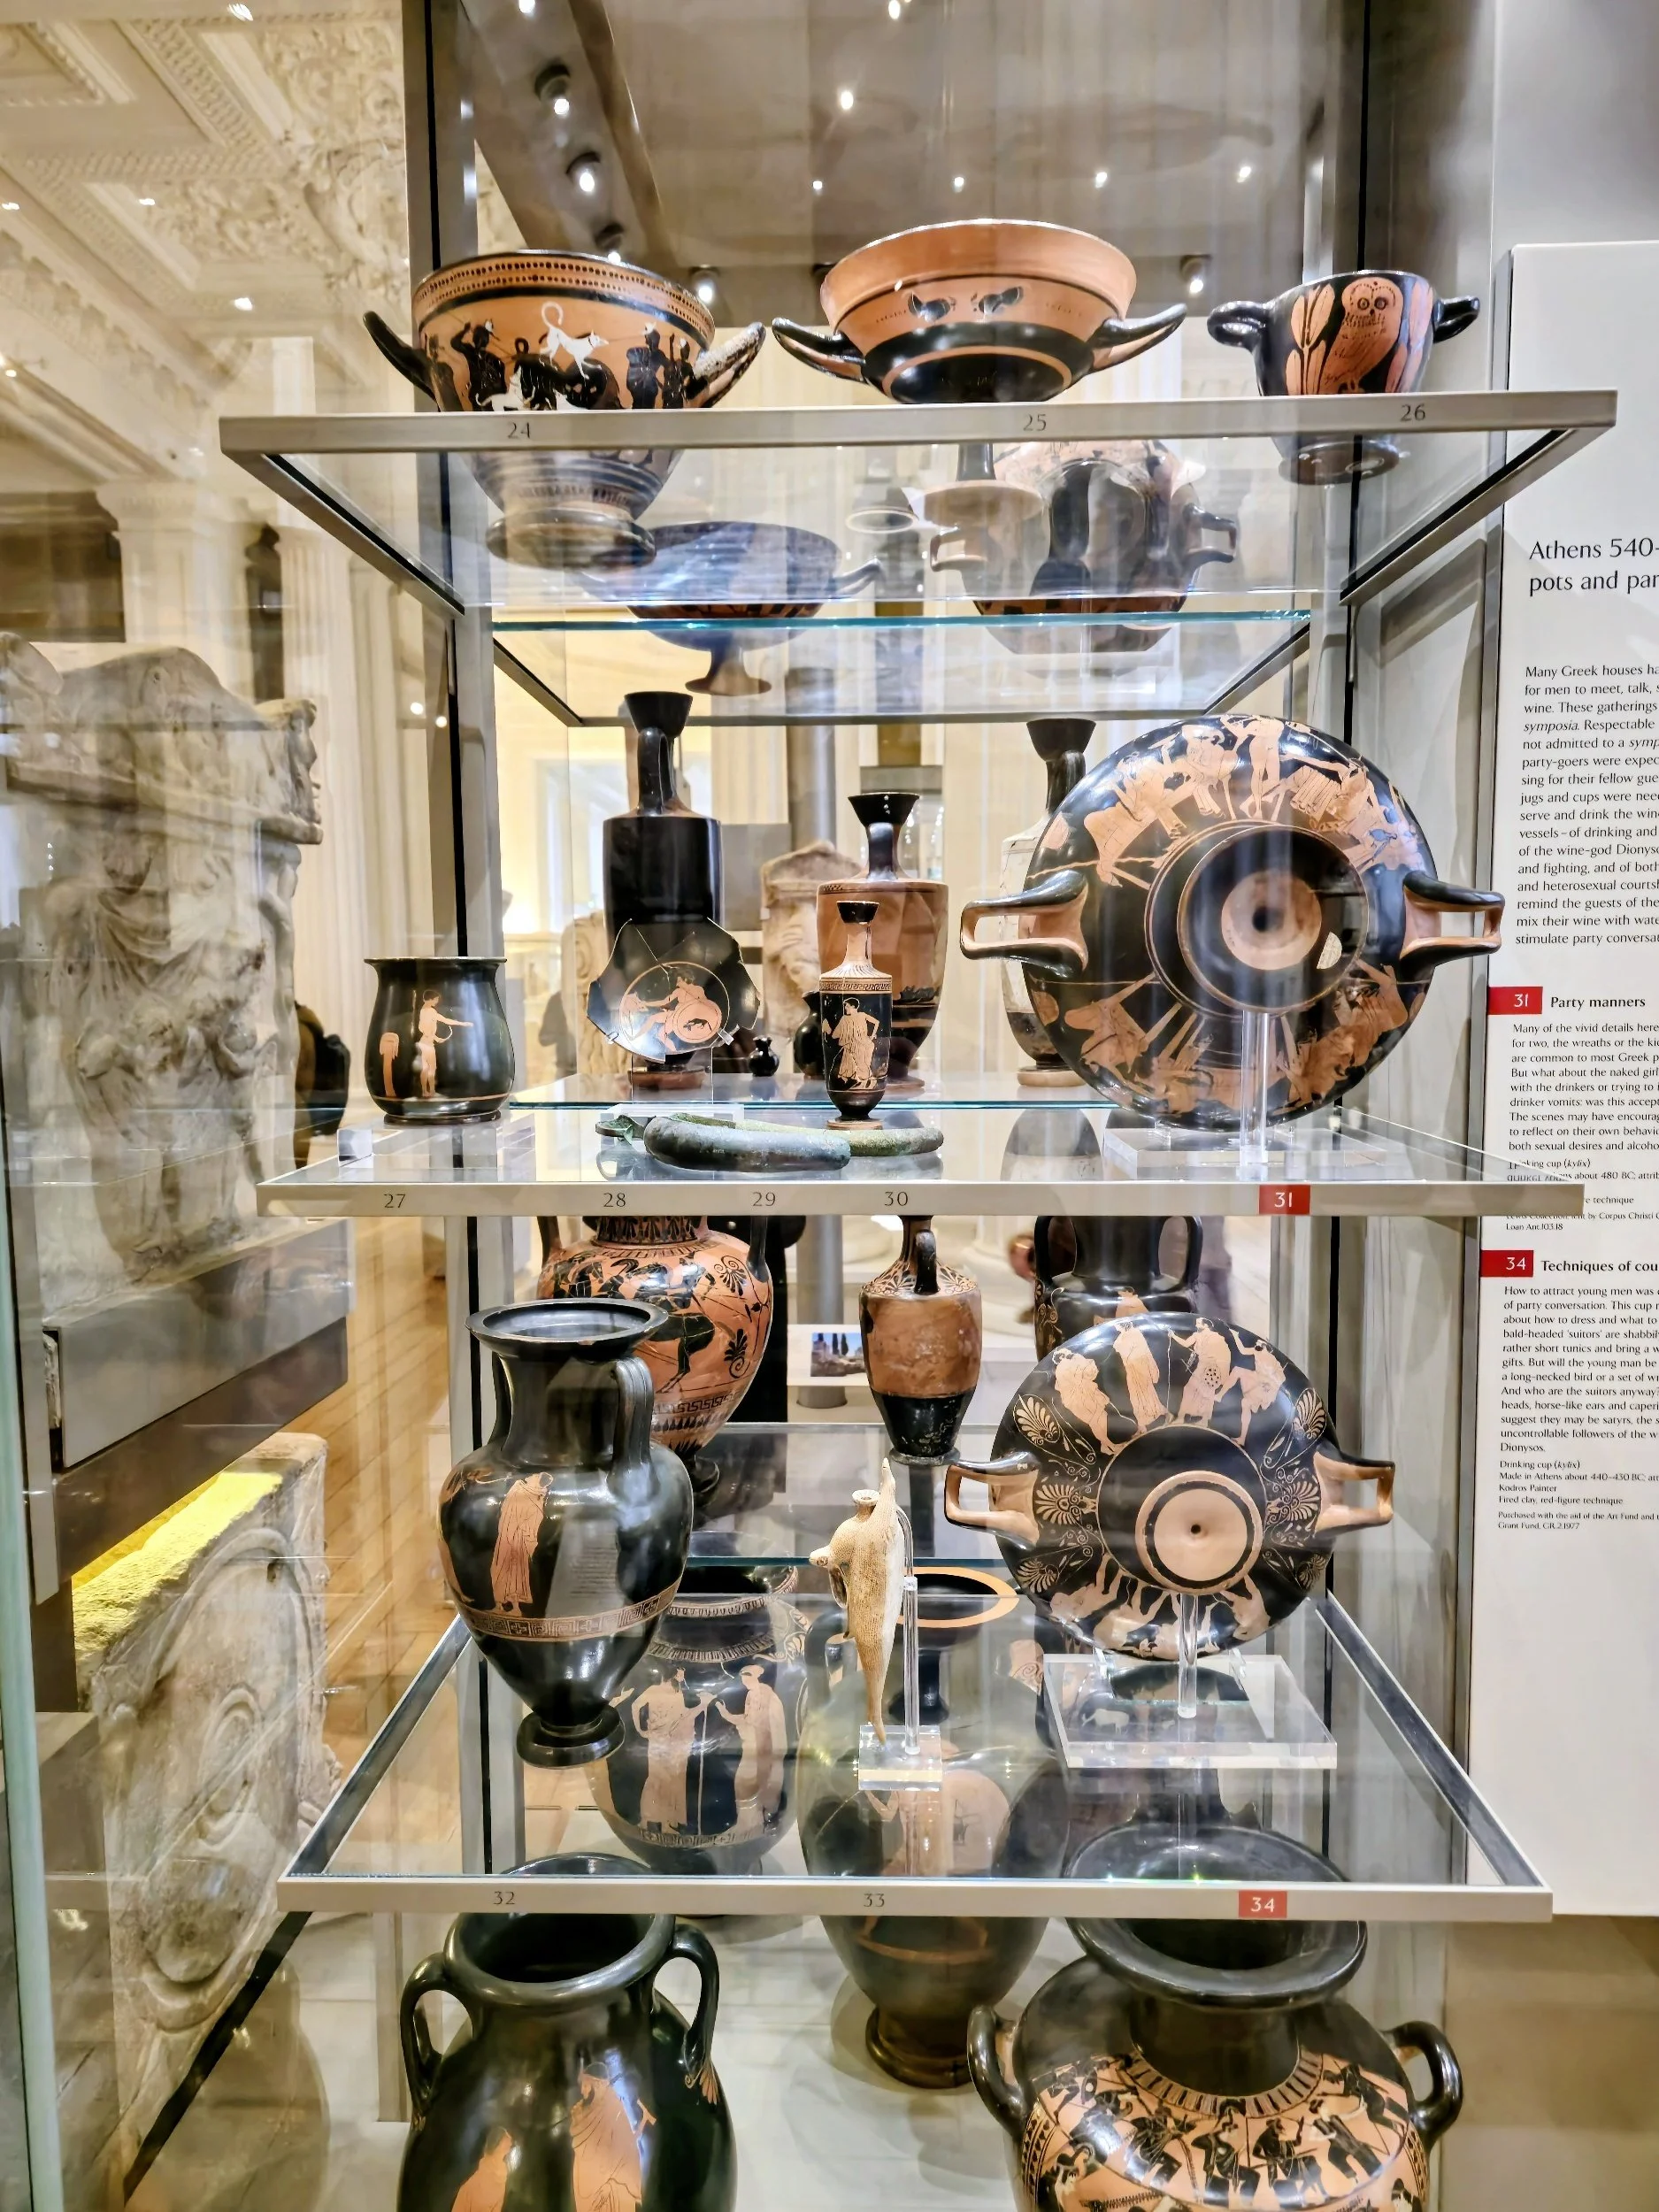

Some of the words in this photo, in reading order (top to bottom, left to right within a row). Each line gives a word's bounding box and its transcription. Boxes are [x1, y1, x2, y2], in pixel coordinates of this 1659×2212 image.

[1400, 403, 1425, 422] 26
[1023, 413, 1047, 432] 25
[506, 421, 531, 440] 24
[1528, 540, 1601, 561] Athens
[1529, 575, 1573, 598] pots
[1580, 569, 1618, 590] and
[1525, 665, 1558, 680] Many
[1561, 664, 1599, 677] Greek
[1602, 664, 1643, 676] houses
[1525, 684, 1541, 696] for
[1544, 686, 1571, 695] men
[1575, 686, 1587, 695] to
[1590, 685, 1624, 695] meet,
[1627, 681, 1652, 695] talk,
[1524, 703, 1555, 714] wine.
[1557, 701, 1594, 713] These
[1596, 700, 1658, 716] gatherings
[1523, 719, 1580, 735] symposia.
[1584, 718, 1655, 733] Respectable
[1523, 741, 1543, 750] not
[1545, 737, 1599, 749] admitted
[1602, 739, 1615, 749] to
[1617, 739, 1624, 749] a
[1522, 757, 1589, 771] party-goers
[1592, 757, 1622, 766] were
[1521, 774, 1545, 788] sing
[1548, 773, 1565, 785] for
[1568, 772, 1596, 785] their
[1599, 772, 1635, 785] fellow
[1636, 774, 1659, 787] gue
[1518, 792, 1544, 807] jugs
[1547, 791, 1569, 803] and
[1572, 794, 1600, 806] cups
[1602, 793, 1632, 802] were
[1519, 812, 1551, 821] serve
[1553, 809, 1576, 821] and
[1578, 808, 1609, 820] drink
[1614, 808, 1633, 820] the
[1518, 826, 1559, 839] vessels
[1569, 826, 1582, 838] of
[1584, 826, 1632, 841] drinking
[1635, 825, 1657, 837] and
[1518, 845, 1532, 856] of
[1533, 844, 1554, 856] the
[1556, 843, 1612, 859] wine-god
[1517, 863, 1540, 874] and
[1543, 862, 1590, 877] fighting,
[1594, 861, 1616, 873] and
[1619, 861, 1632, 873] of
[1517, 879, 1539, 892] and
[1542, 879, 1617, 892] heterosexual
[1517, 897, 1558, 910] remind
[1562, 897, 1581, 909] the
[1584, 899, 1622, 912] guests
[1625, 896, 1639, 908] of
[1516, 916, 1539, 927] mix
[1542, 915, 1570, 926] their
[1572, 915, 1601, 926] wine
[1604, 914, 1630, 926] with
[1515, 933, 1569, 945] stimulate
[1572, 934, 1603, 947] party
[1514, 993, 1529, 1008] 31
[1550, 996, 1586, 1011] Party
[1589, 998, 1646, 1008] manners
[1513, 1023, 1540, 1036] Many
[1542, 1023, 1554, 1033] of
[1555, 1023, 1572, 1033] the
[1575, 1023, 1599, 1033] vivid
[1601, 1022, 1634, 1033] details
[1511, 1067, 1528, 1078] But
[1531, 1068, 1556, 1078] what
[1558, 1067, 1587, 1078] about
[1590, 1067, 1607, 1077] the
[1609, 1066, 1640, 1077] naked
[1522, 1126, 1554, 1136] reflect
[1572, 1125, 1596, 1136] their
[1509, 1141, 1532, 1151] both
[1534, 1141, 1565, 1151] sexual
[1568, 1141, 1603, 1151] desires
[1605, 1141, 1624, 1151] and
[383, 1193, 406, 1209] 27
[603, 1192, 626, 1208] 28
[752, 1191, 777, 1207] 29
[884, 1190, 910, 1207] 30
[1274, 1191, 1293, 1208] 31
[1506, 1256, 1526, 1271] 34
[1540, 1260, 1614, 1275] Techniques
[1617, 1260, 1632, 1272] of
[1504, 1286, 1527, 1295] How
[1530, 1287, 1540, 1296] to
[1542, 1287, 1575, 1296] attract
[1578, 1288, 1608, 1299] young
[1610, 1287, 1632, 1296] men
[1502, 1314, 1532, 1325] about
[1534, 1314, 1555, 1325] how
[1571, 1314, 1596, 1325] dress
[1598, 1314, 1617, 1325] and
[1619, 1315, 1644, 1325] what
[1528, 1357, 1546, 1367] But
[1548, 1357, 1565, 1367] will
[1568, 1357, 1585, 1368] the
[1586, 1360, 1617, 1371] young
[1645, 1357, 1657, 1368] be
[1501, 1386, 1521, 1395] And
[1524, 1386, 1546, 1395] who
[1566, 1386, 1583, 1396] the
[1585, 1386, 1617, 1396] suitors
[493, 1891, 515, 1905] 32
[863, 1893, 885, 1907] 33
[1250, 1896, 1275, 1912] 34
